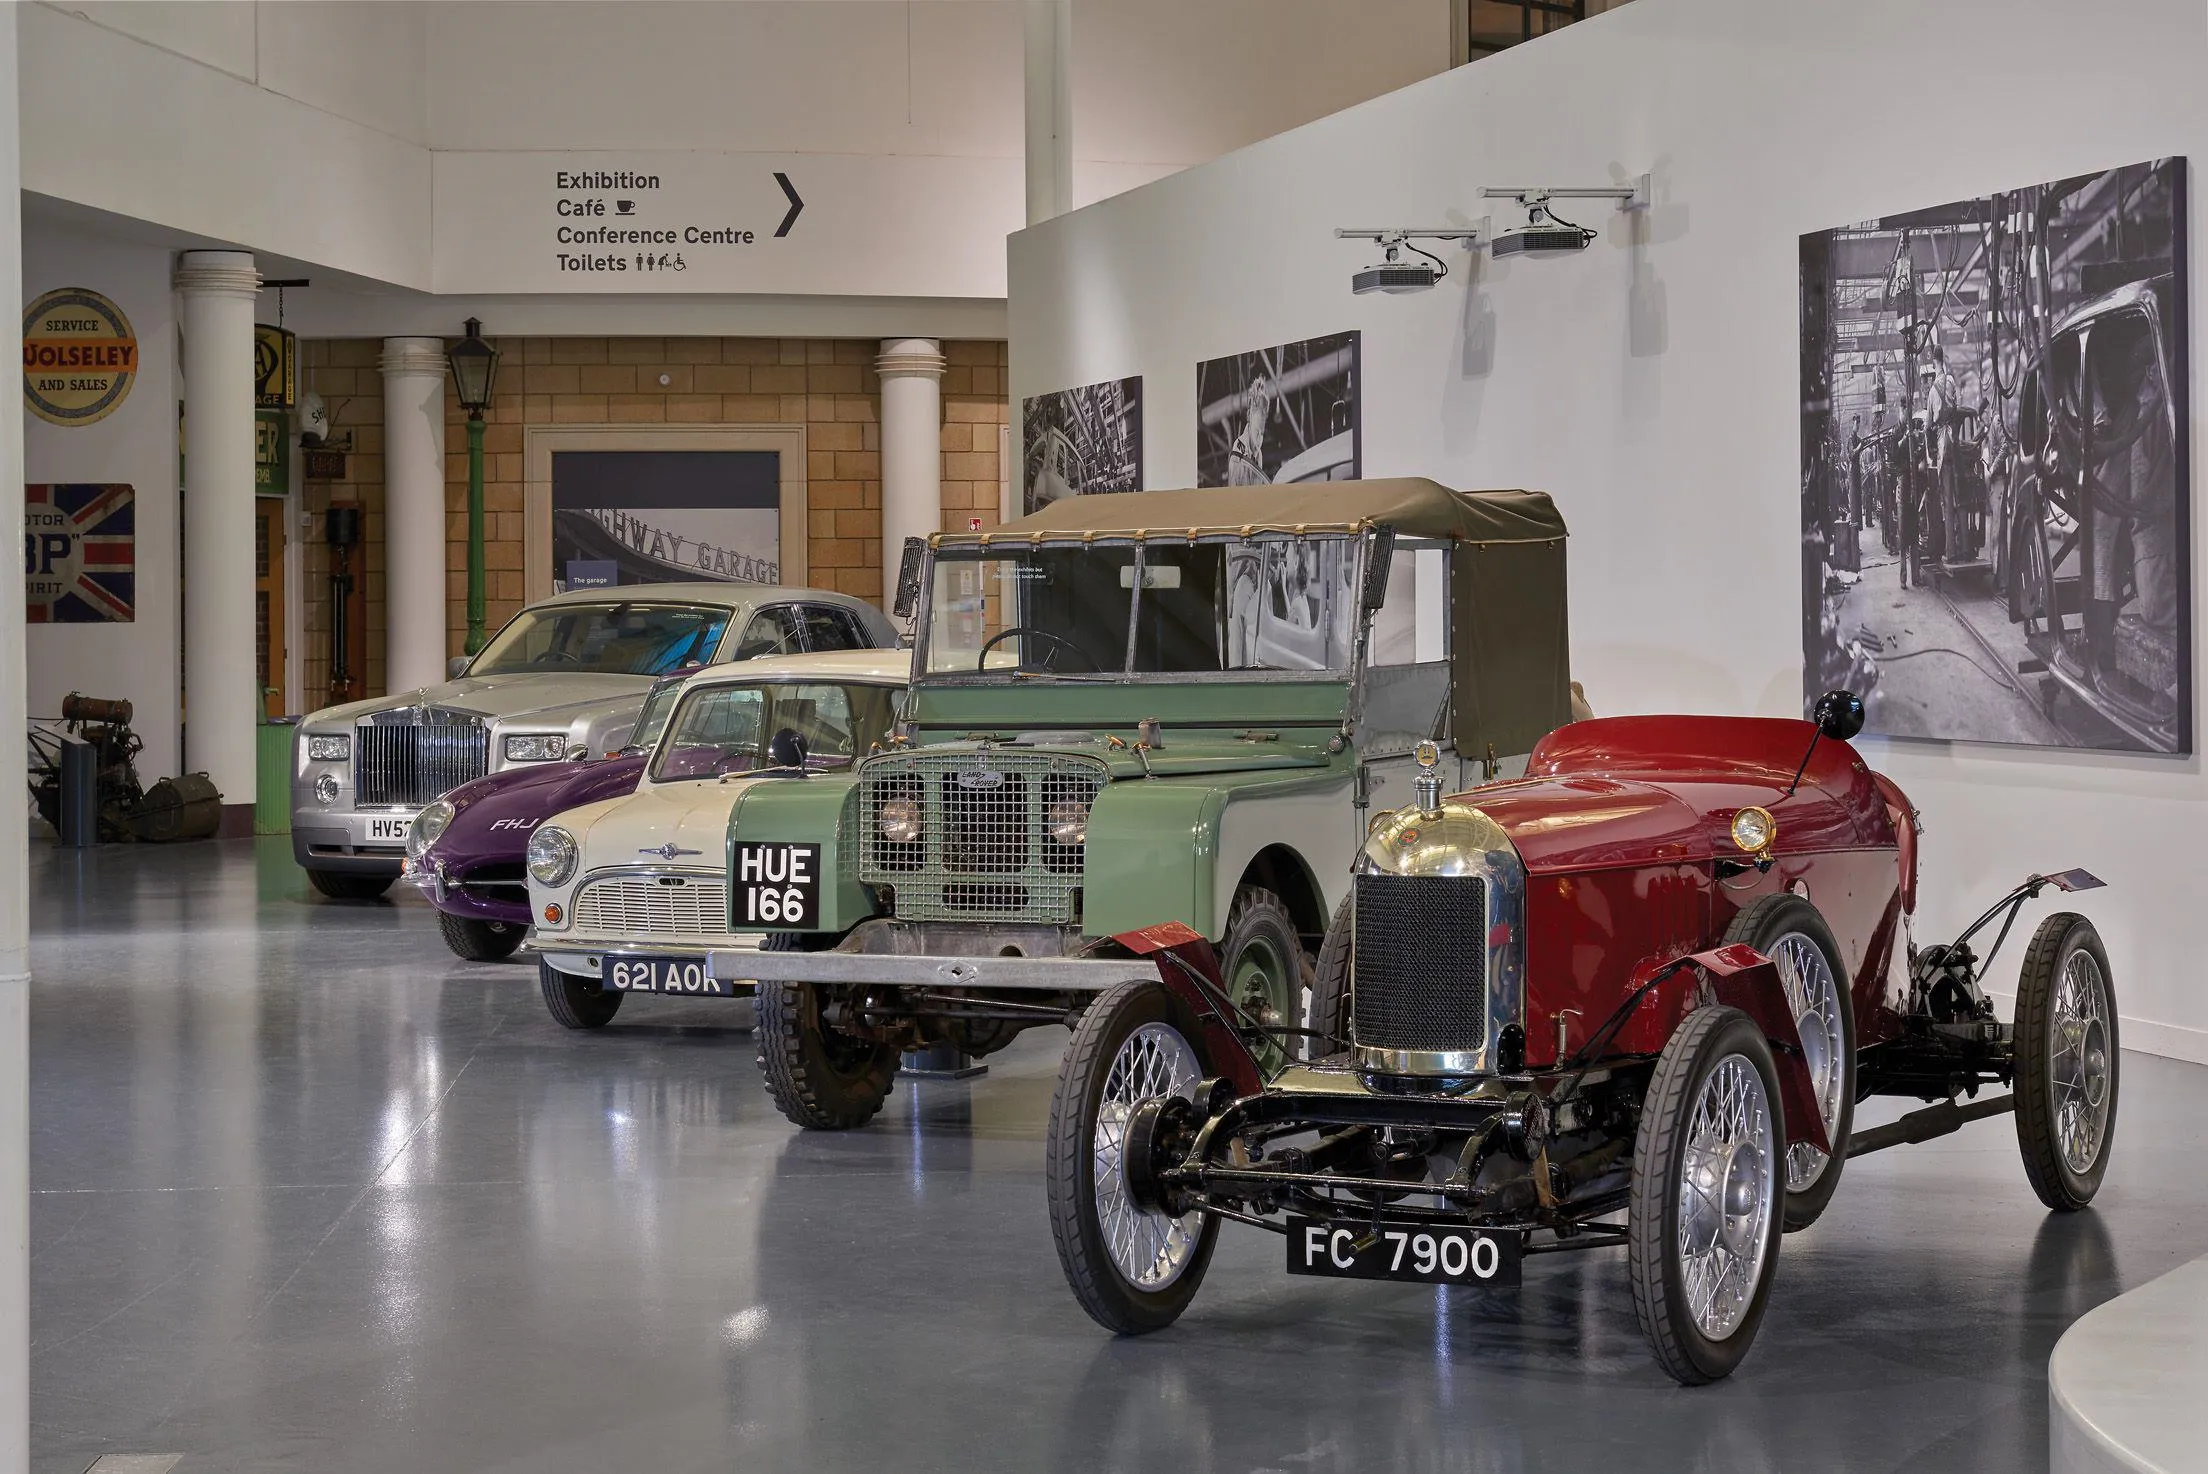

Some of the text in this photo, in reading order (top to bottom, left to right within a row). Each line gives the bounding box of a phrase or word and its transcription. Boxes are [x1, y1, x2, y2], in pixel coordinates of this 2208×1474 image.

[556, 171, 660, 189] Exhibition
[556, 199, 605, 217] Café
[556, 226, 755, 244] Conference Centre
[556, 253, 627, 271] Toilets
[46, 320, 99, 332] SERVICE
[38, 380, 108, 391] AND SALES
[698, 542, 778, 585] GARAGE
[586, 578, 607, 586] garage
[490, 818, 540, 830] FHJ
[741, 847, 812, 883] HUE
[747, 887, 804, 923] 166
[613, 962, 657, 990] 621
[1305, 1226, 1499, 1279] FC 7900
